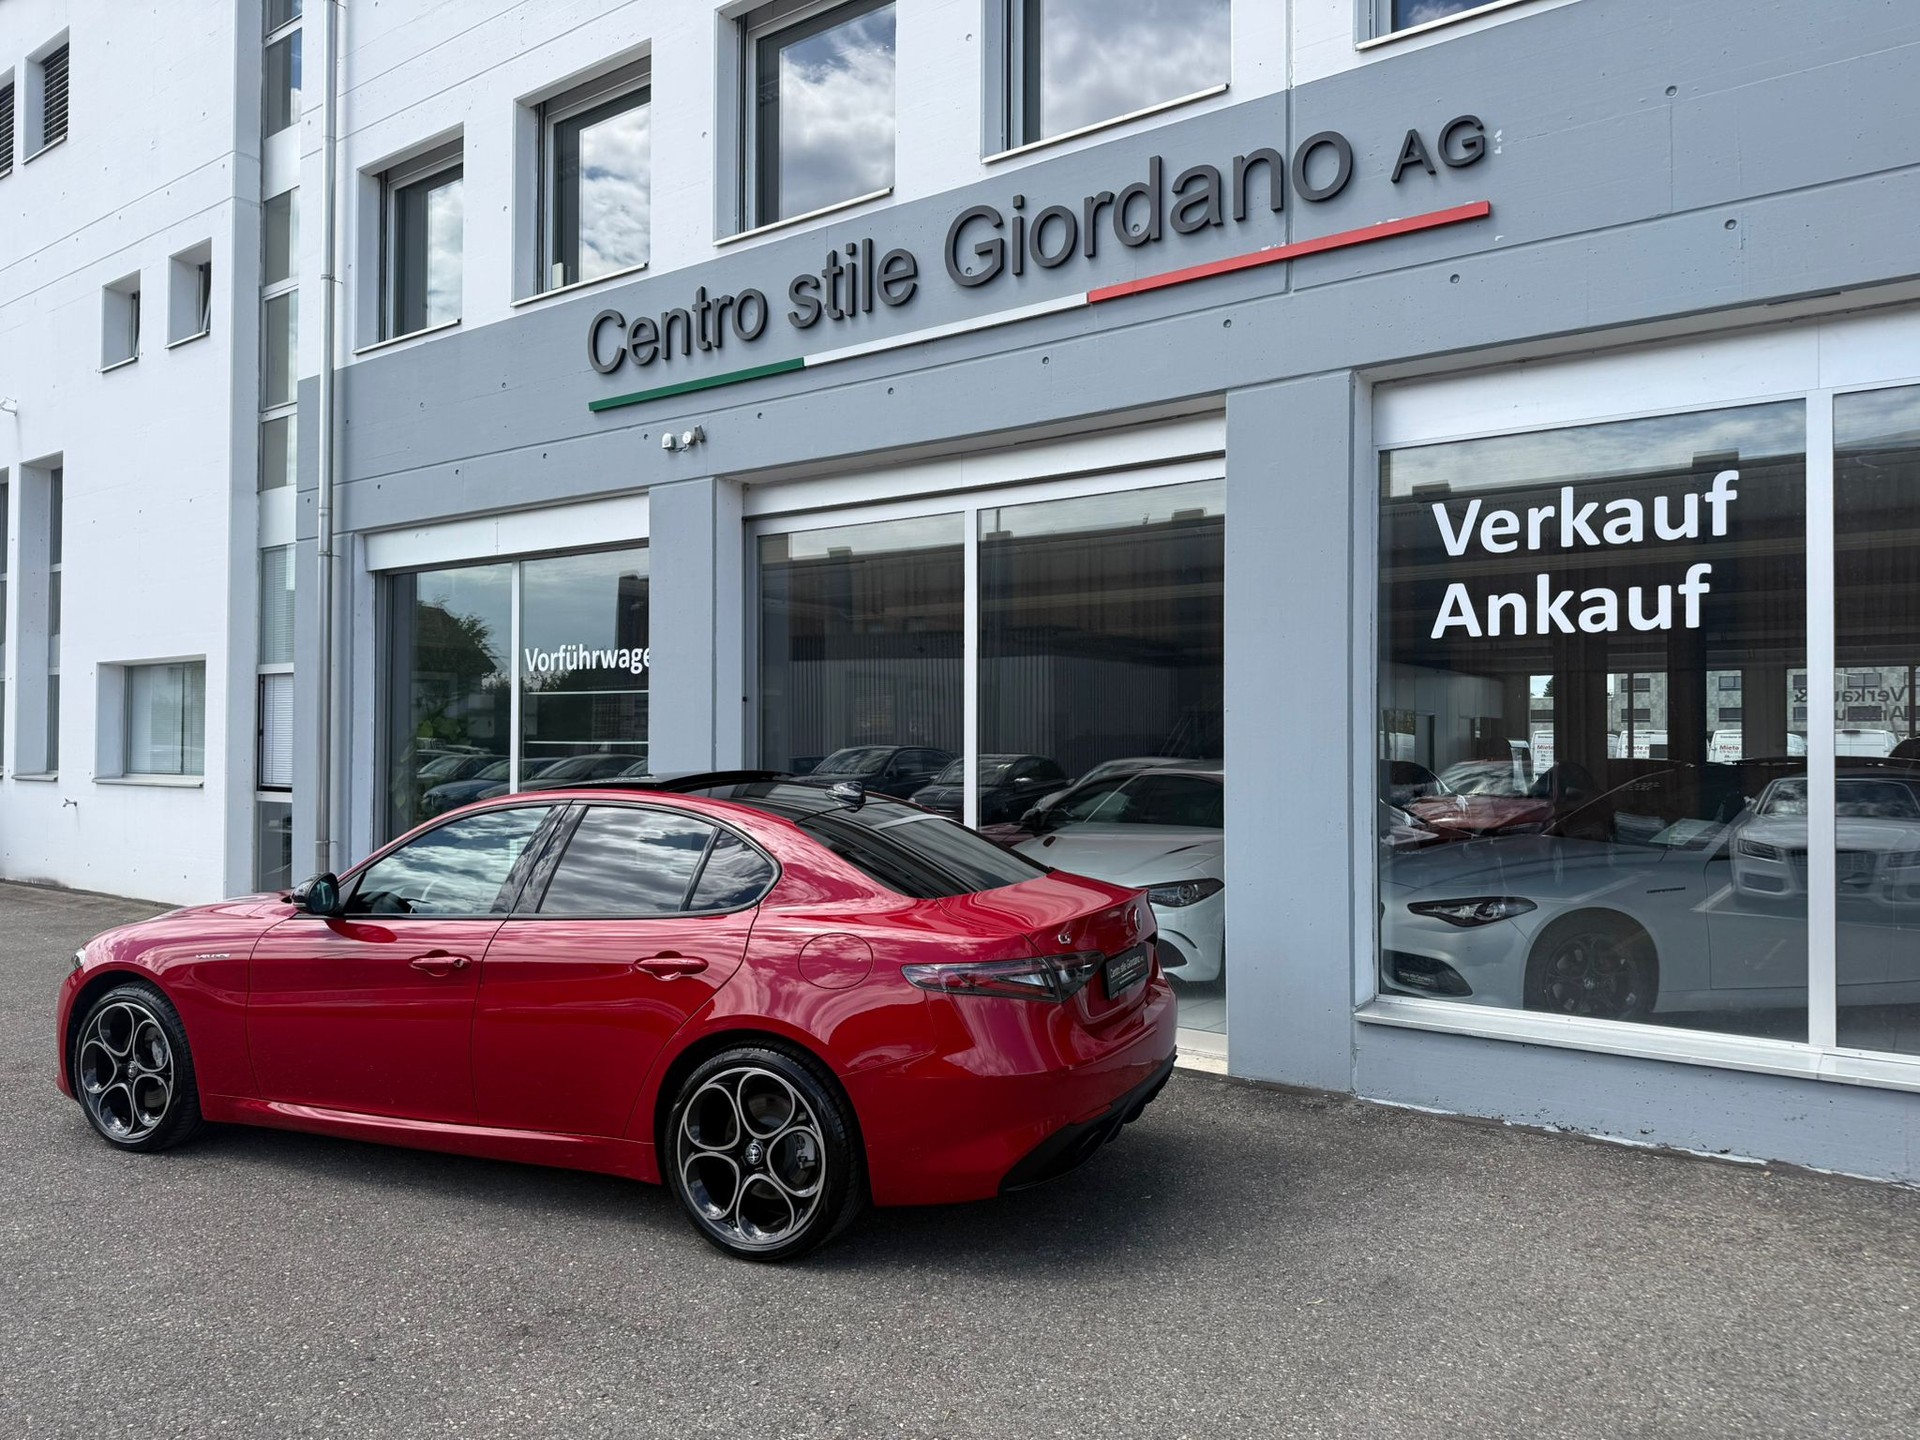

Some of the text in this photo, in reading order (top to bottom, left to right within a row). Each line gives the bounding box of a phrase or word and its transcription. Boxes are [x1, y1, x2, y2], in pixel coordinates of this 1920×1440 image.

[588, 115, 1485, 374] Centro stile Giordano AG
[1432, 470, 1739, 556] Verkauf
[1431, 563, 1712, 639] Ankauf
